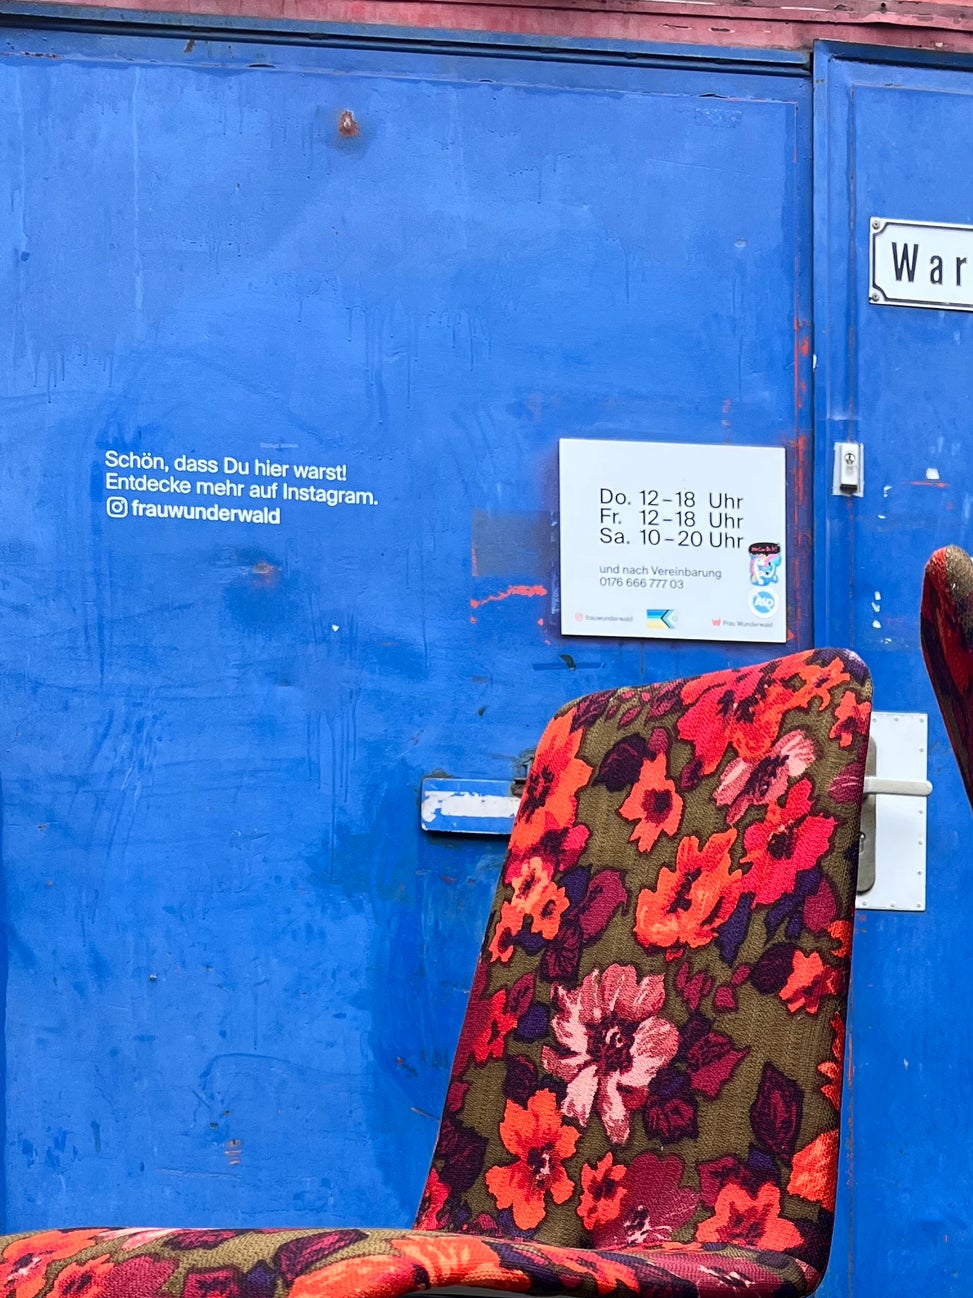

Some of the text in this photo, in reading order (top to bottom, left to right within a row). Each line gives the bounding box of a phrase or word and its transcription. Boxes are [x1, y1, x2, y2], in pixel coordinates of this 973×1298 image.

[105, 450, 347, 481] Schön, dass Du hier warst!
[106, 473, 379, 506] Entdecke mehr auf Instagram.
[600, 488, 631, 506] Do.
[709, 492, 744, 510] Uhr
[132, 500, 281, 525] frauwunderwald
[600, 508, 622, 525] Fr.
[709, 512, 744, 529] Uhr
[600, 527, 631, 544] Sa.
[709, 532, 744, 549] Uhr
[600, 565, 722, 580] und nach Vereinbarung
[600, 577, 684, 589] 0176 666 777 03
